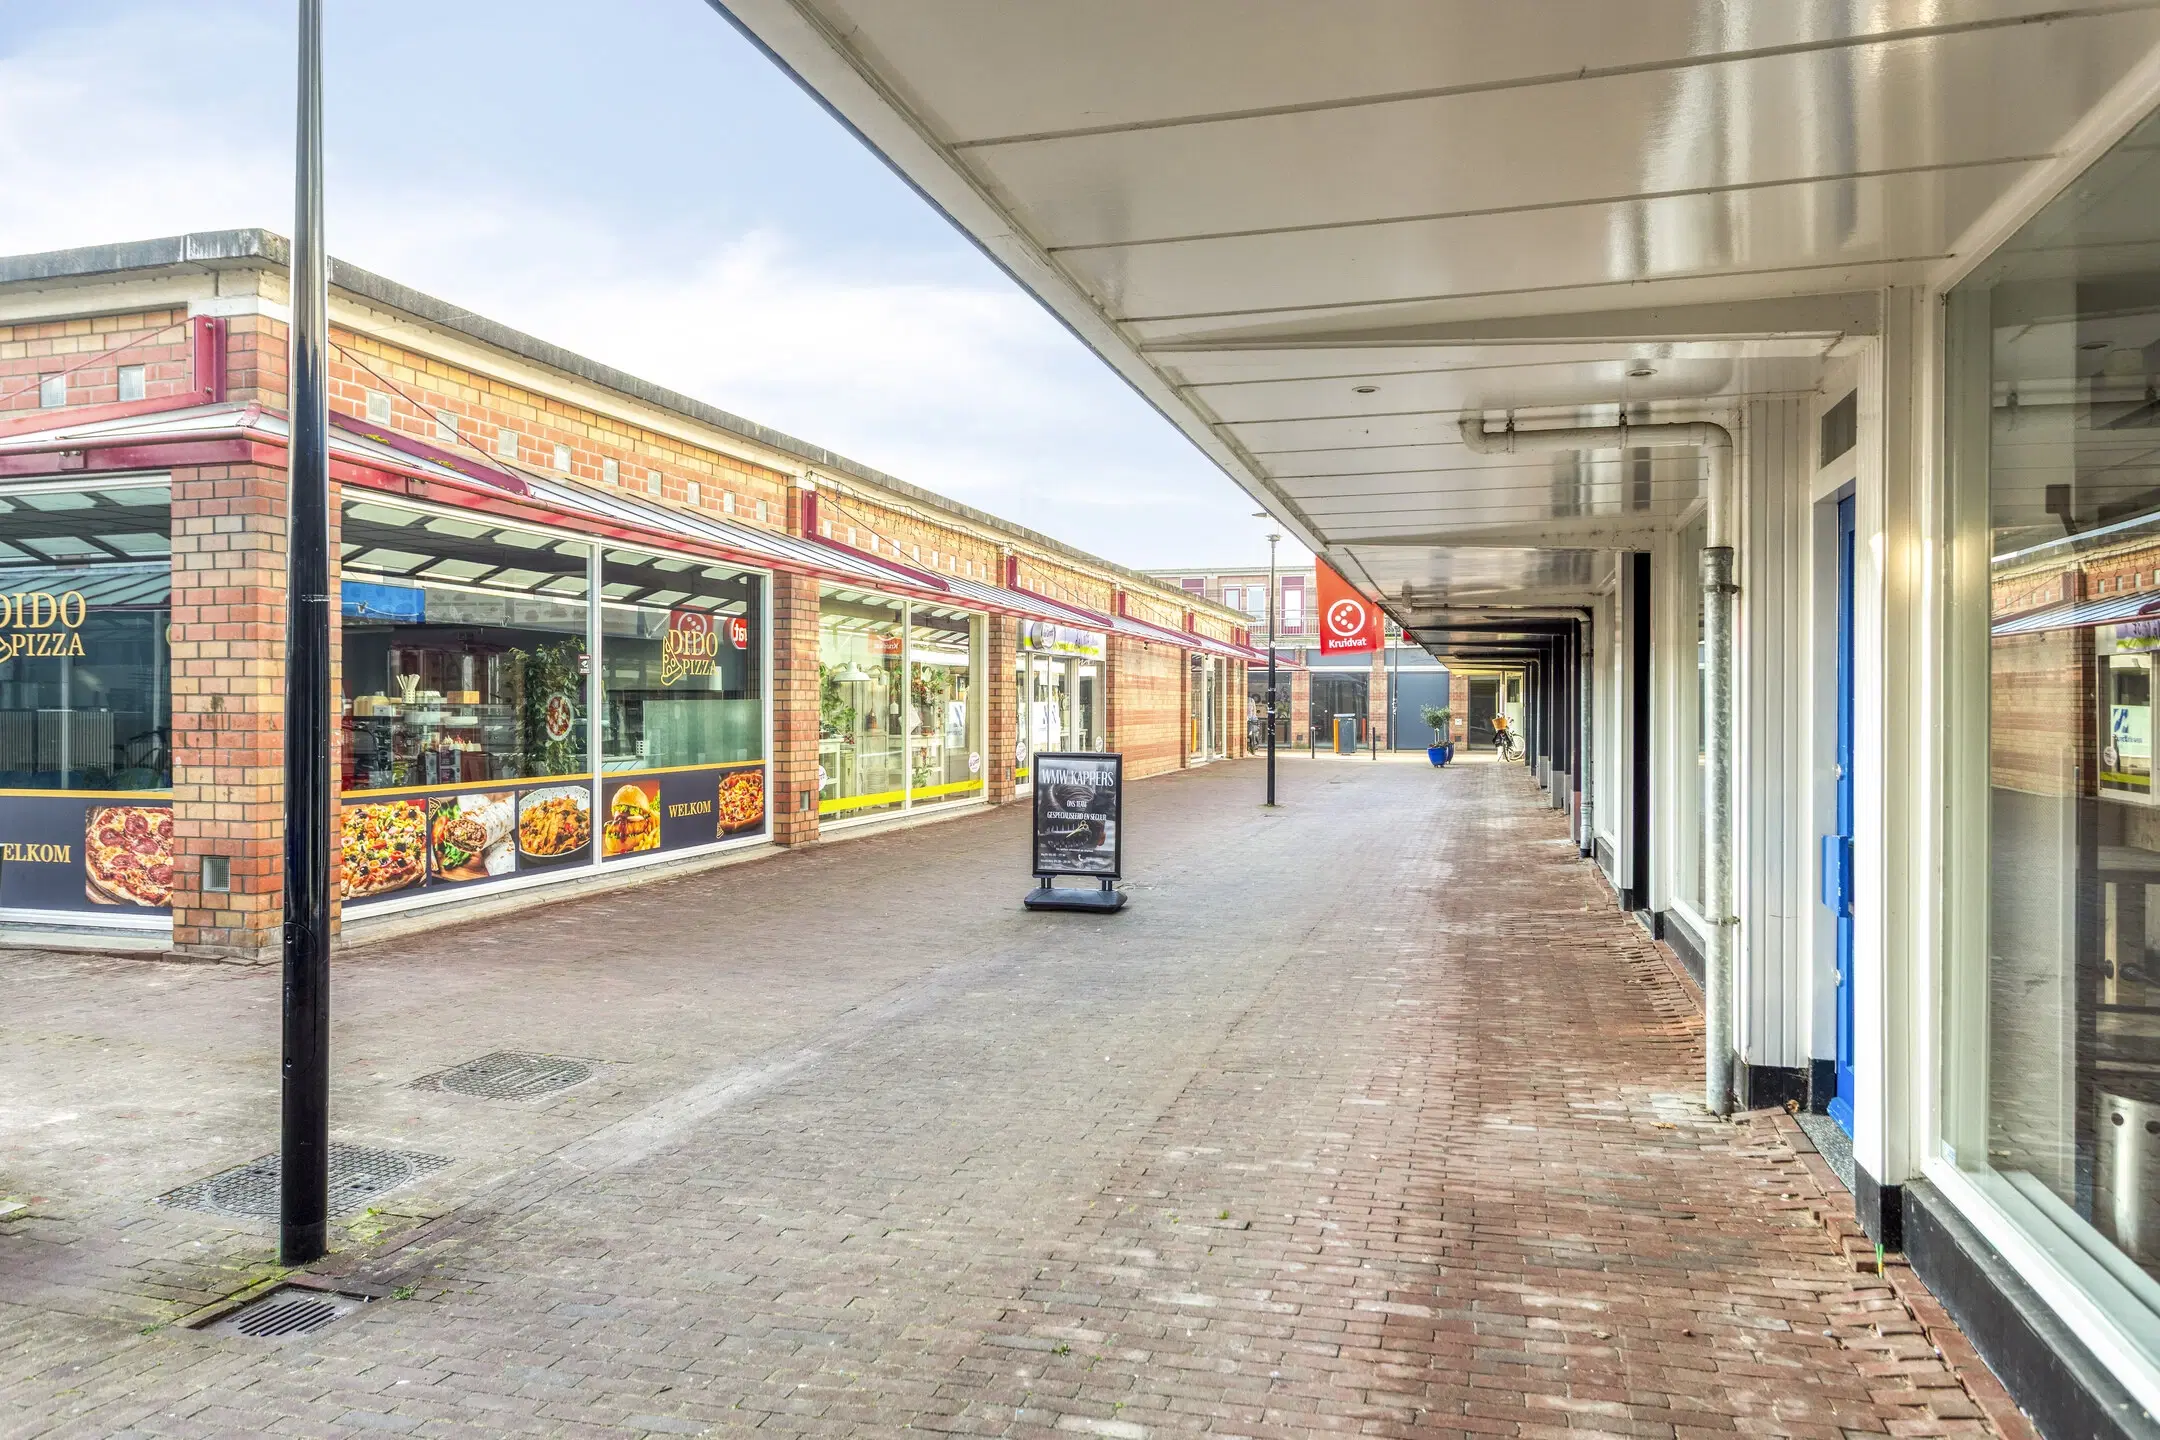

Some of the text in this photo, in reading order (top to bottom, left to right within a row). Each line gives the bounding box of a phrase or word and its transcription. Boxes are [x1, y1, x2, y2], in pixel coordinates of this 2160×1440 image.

[10, 632, 86, 657] PIZZA
[669, 629, 719, 657] DIDO
[1328, 637, 1367, 649] Kruidvat
[682, 659, 718, 676] PIZZA
[1042, 769, 1114, 787] WMW KAPPERS
[668, 800, 712, 818] WELKOM
[1066, 799, 1076, 808] ONS
